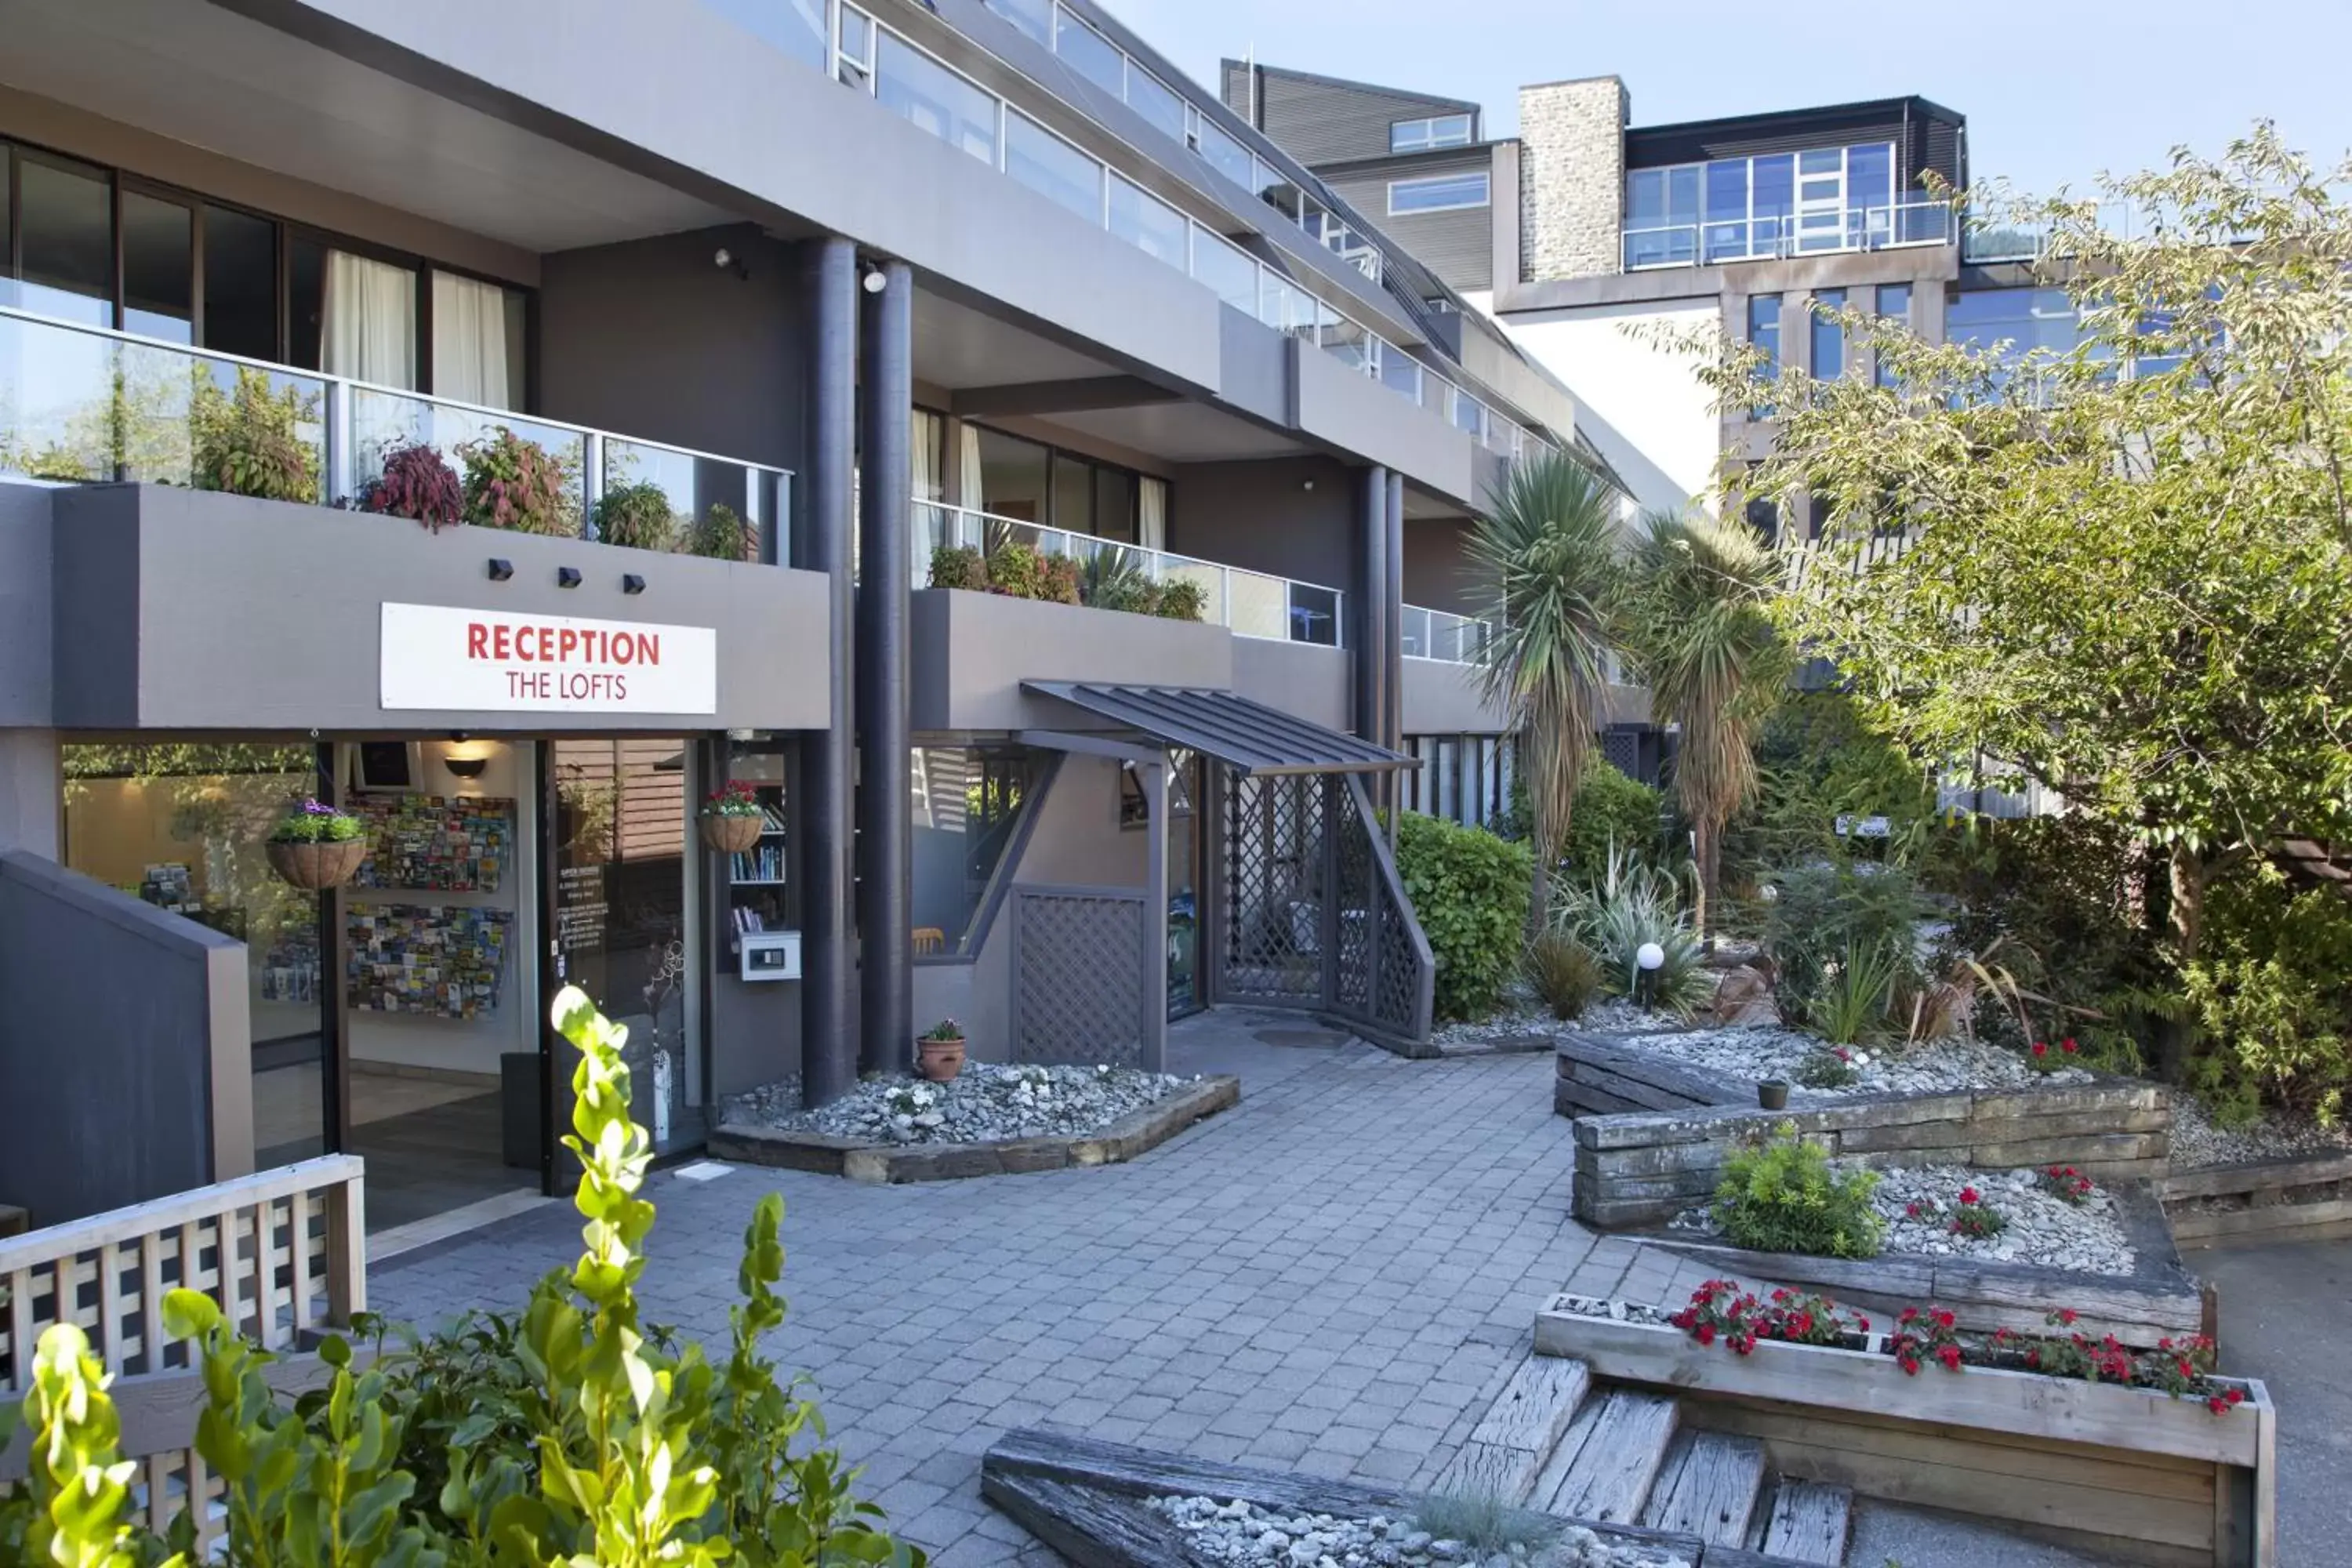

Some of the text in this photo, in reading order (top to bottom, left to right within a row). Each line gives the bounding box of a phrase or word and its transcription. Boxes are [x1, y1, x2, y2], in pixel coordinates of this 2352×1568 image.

[467, 622, 659, 666] RECEPTION
[506, 671, 626, 700] THE LOFTS
